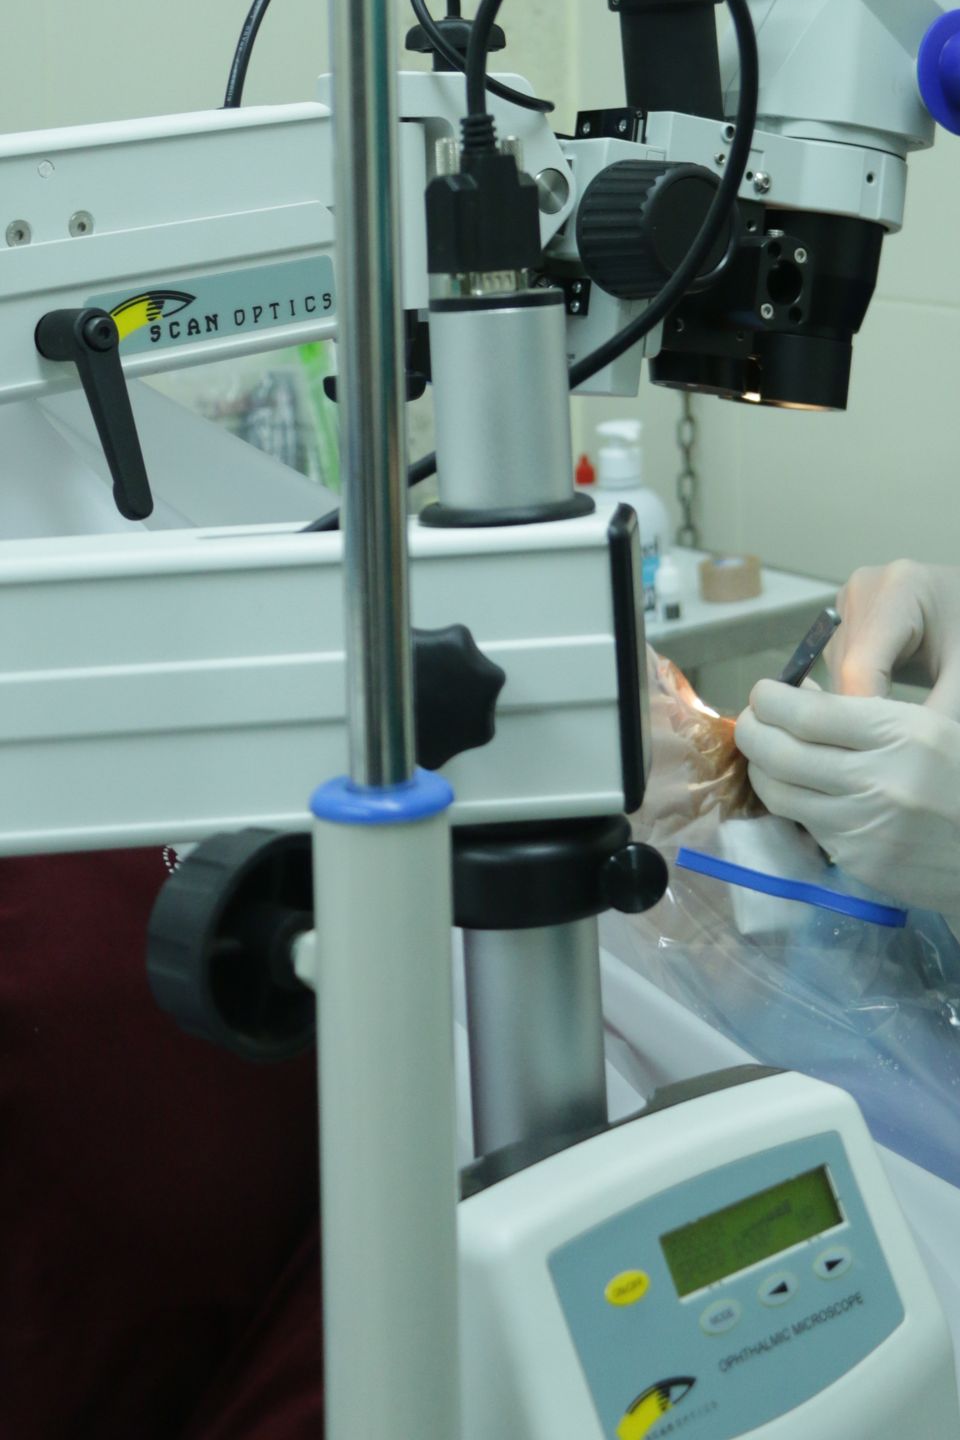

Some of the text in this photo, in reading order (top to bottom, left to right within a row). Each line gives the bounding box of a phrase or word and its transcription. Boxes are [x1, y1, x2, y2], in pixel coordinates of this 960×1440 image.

[150, 292, 333, 343] SCAN OPTICS
[718, 1291, 864, 1373] OPHTHALMIC MICROSCOPE
